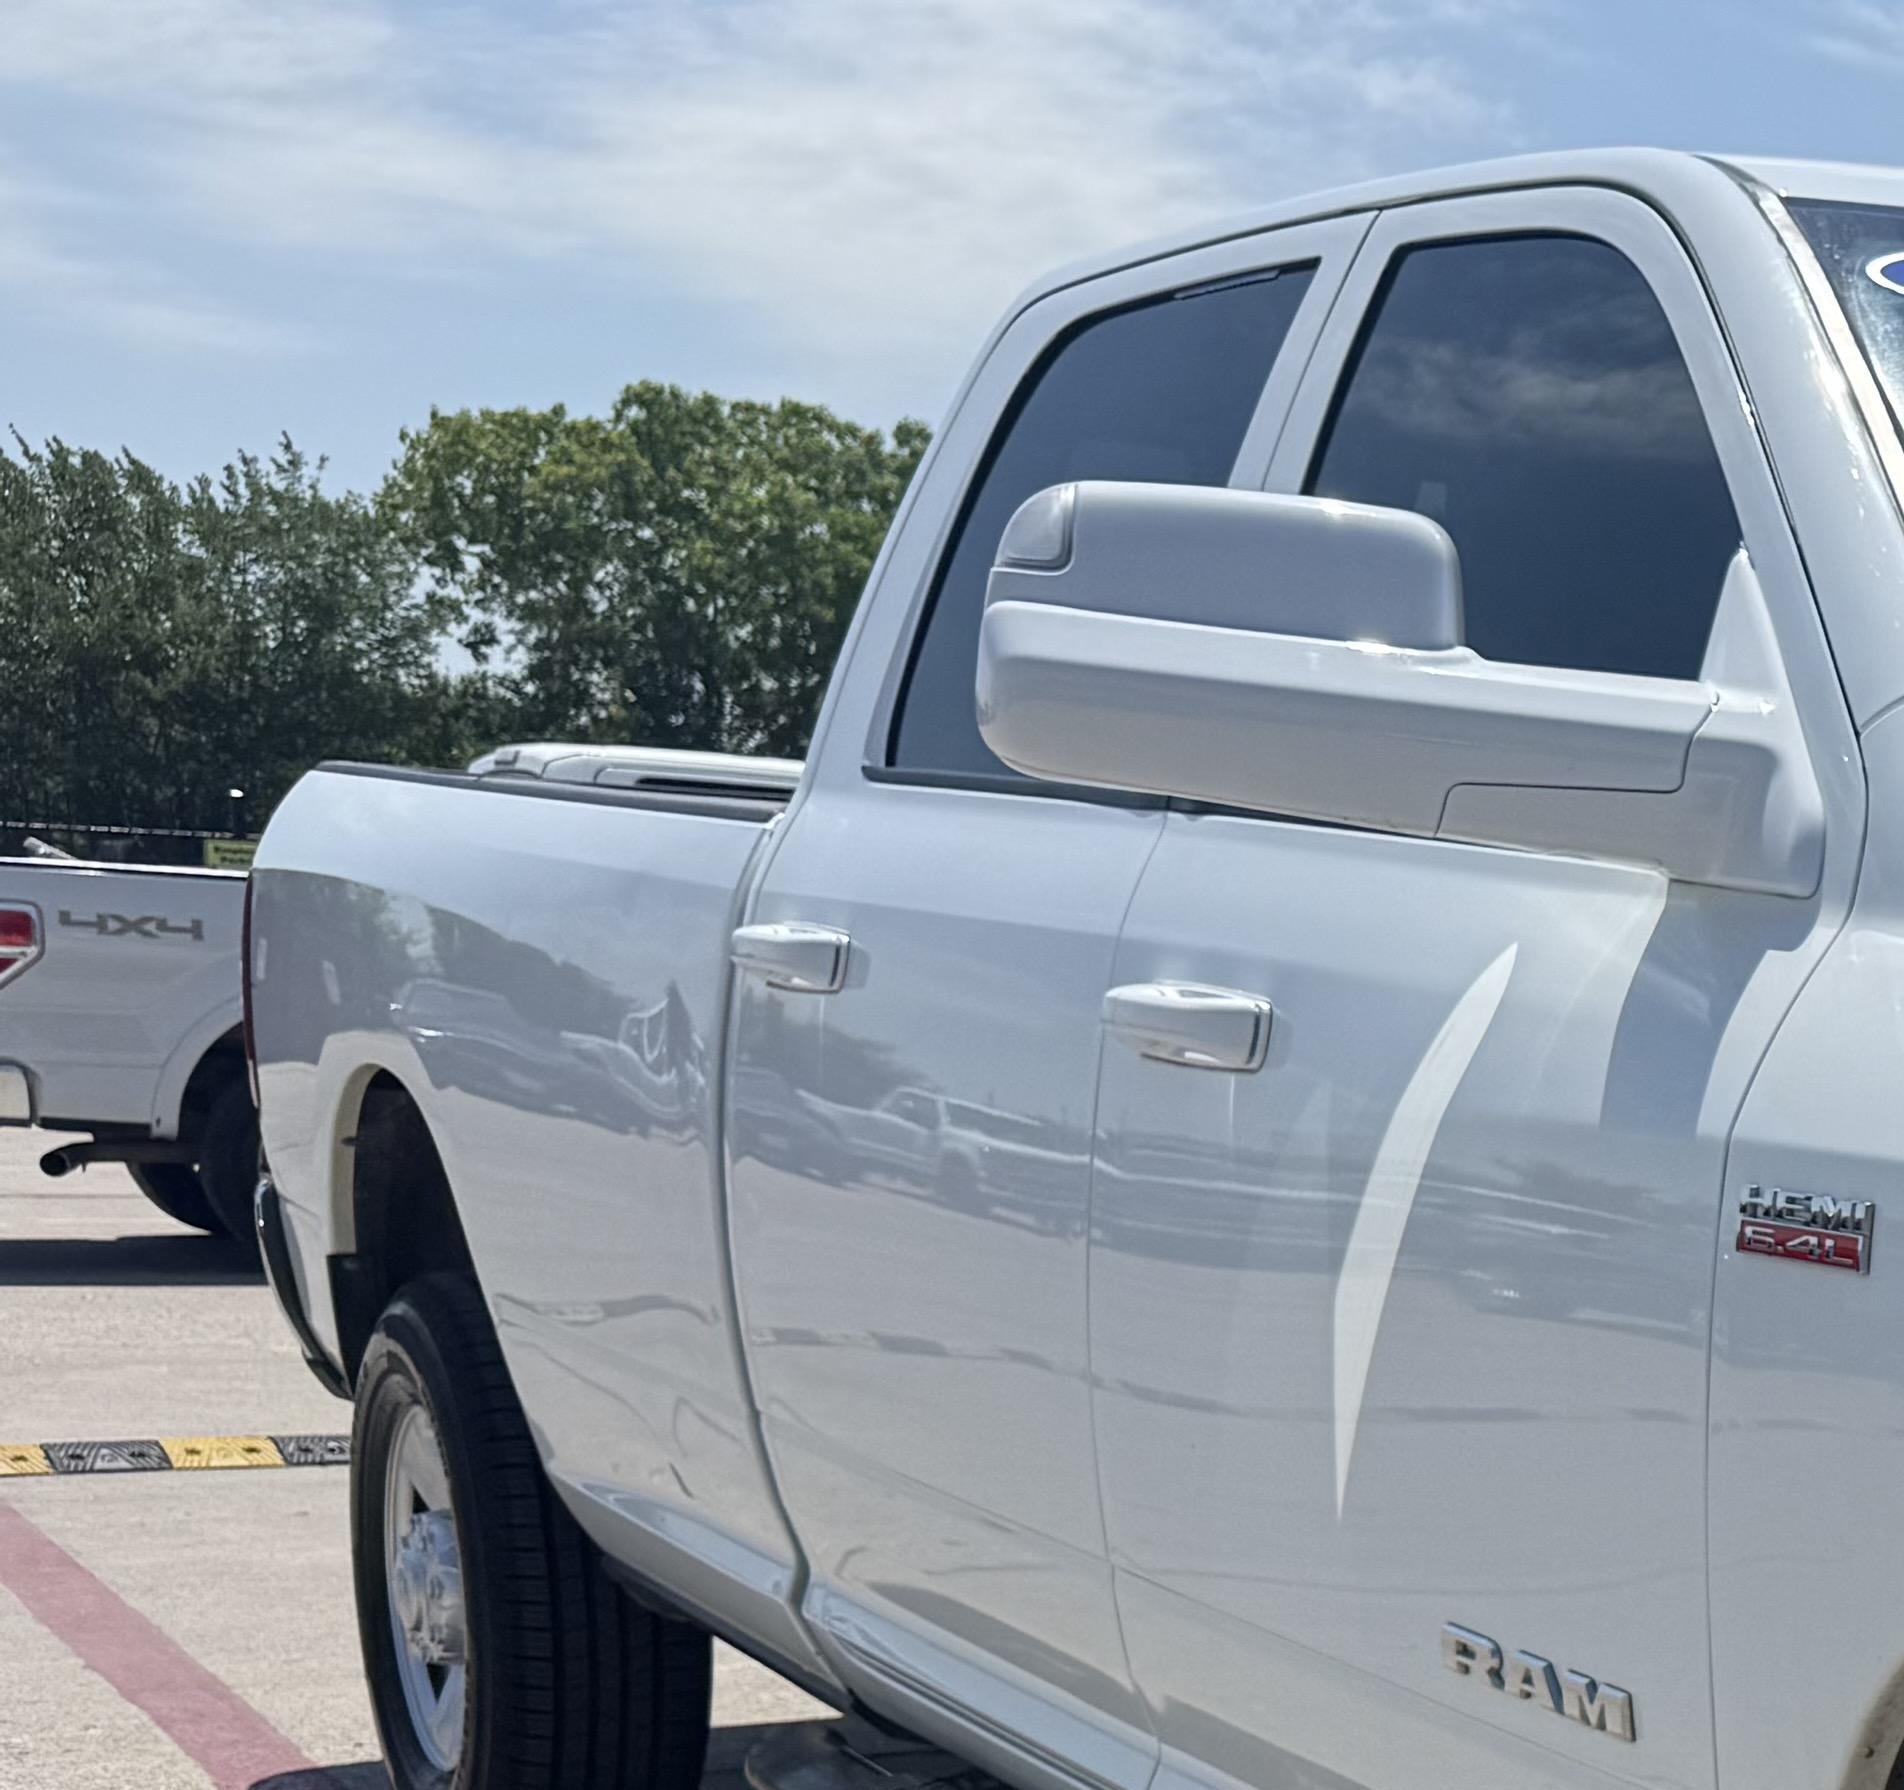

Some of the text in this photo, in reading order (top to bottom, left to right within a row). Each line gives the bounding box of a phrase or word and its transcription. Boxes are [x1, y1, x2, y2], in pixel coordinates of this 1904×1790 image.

[1739, 1184, 1876, 1234] HEMI
[1744, 1225, 1853, 1265] 6.4L
[1440, 1620, 1637, 1743] RAM
